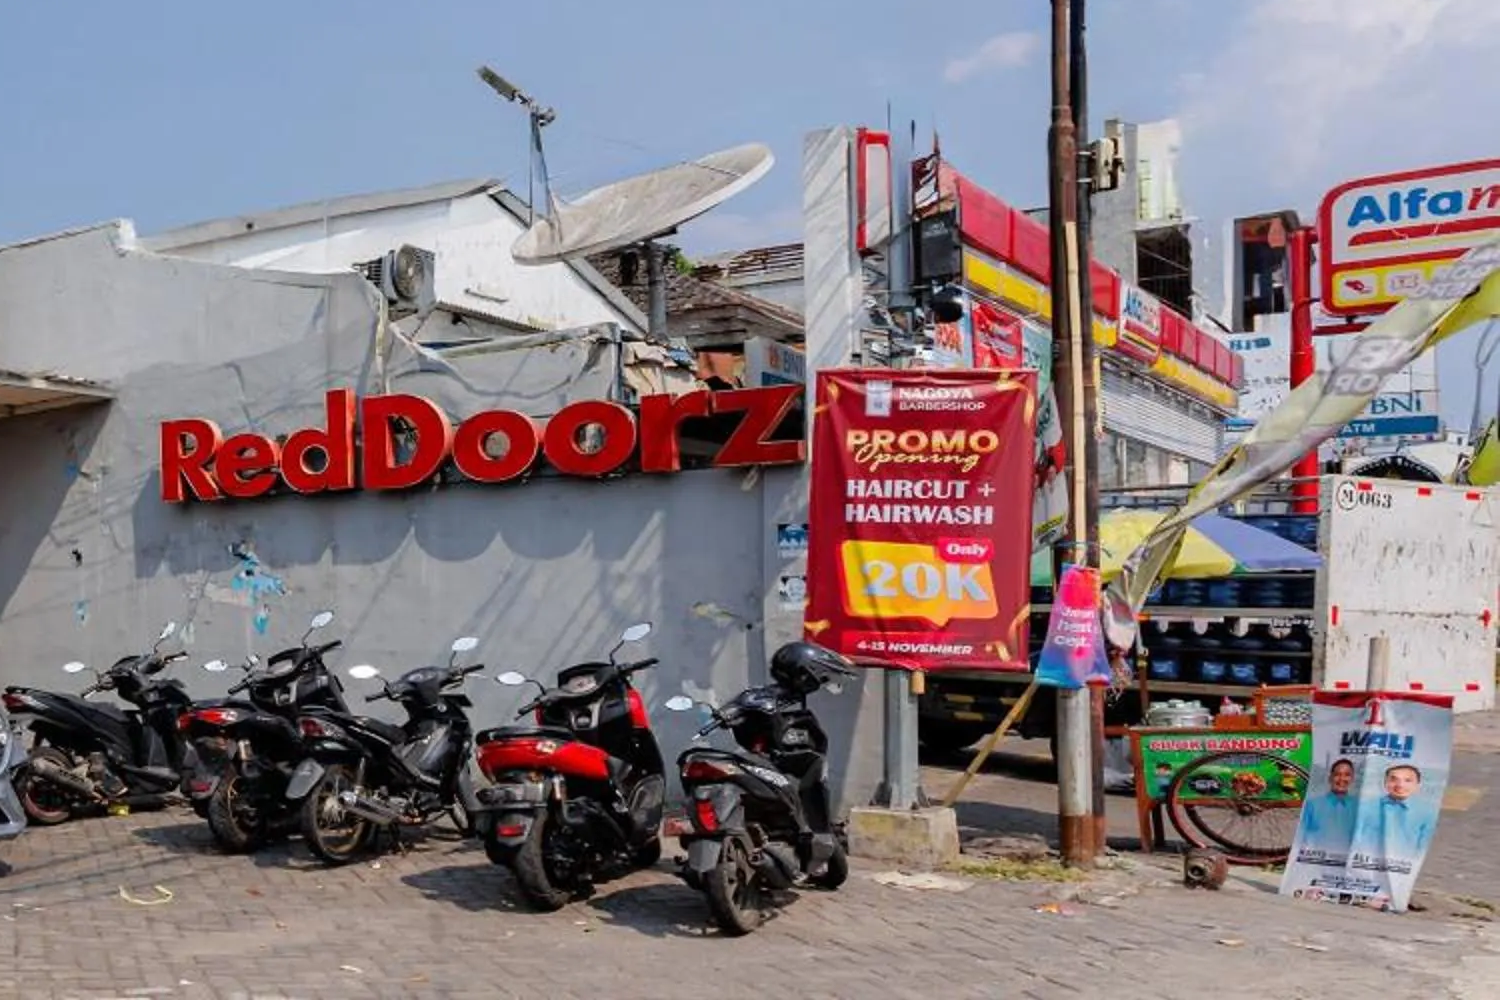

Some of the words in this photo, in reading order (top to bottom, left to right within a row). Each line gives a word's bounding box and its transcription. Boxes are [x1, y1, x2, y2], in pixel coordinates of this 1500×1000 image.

[899, 387, 975, 400] NAGOYA
[1370, 390, 1422, 415] BNI
[899, 401, 987, 412] BARBERSHOP
[1342, 422, 1376, 433] ATM
[160, 388, 807, 503] RedDoorz
[846, 429, 1000, 453] PROMO
[855, 442, 981, 473] Opening
[846, 479, 970, 499] HAIRCUT
[845, 503, 994, 525] HAIRWASH
[946, 542, 989, 558] Only
[861, 559, 991, 601] 20K
[856, 640, 886, 652] 4-15
[887, 641, 974, 656] NOVEMBER
[1204, 737, 1301, 751] BANDUNG
[1340, 731, 1415, 752] WALI
